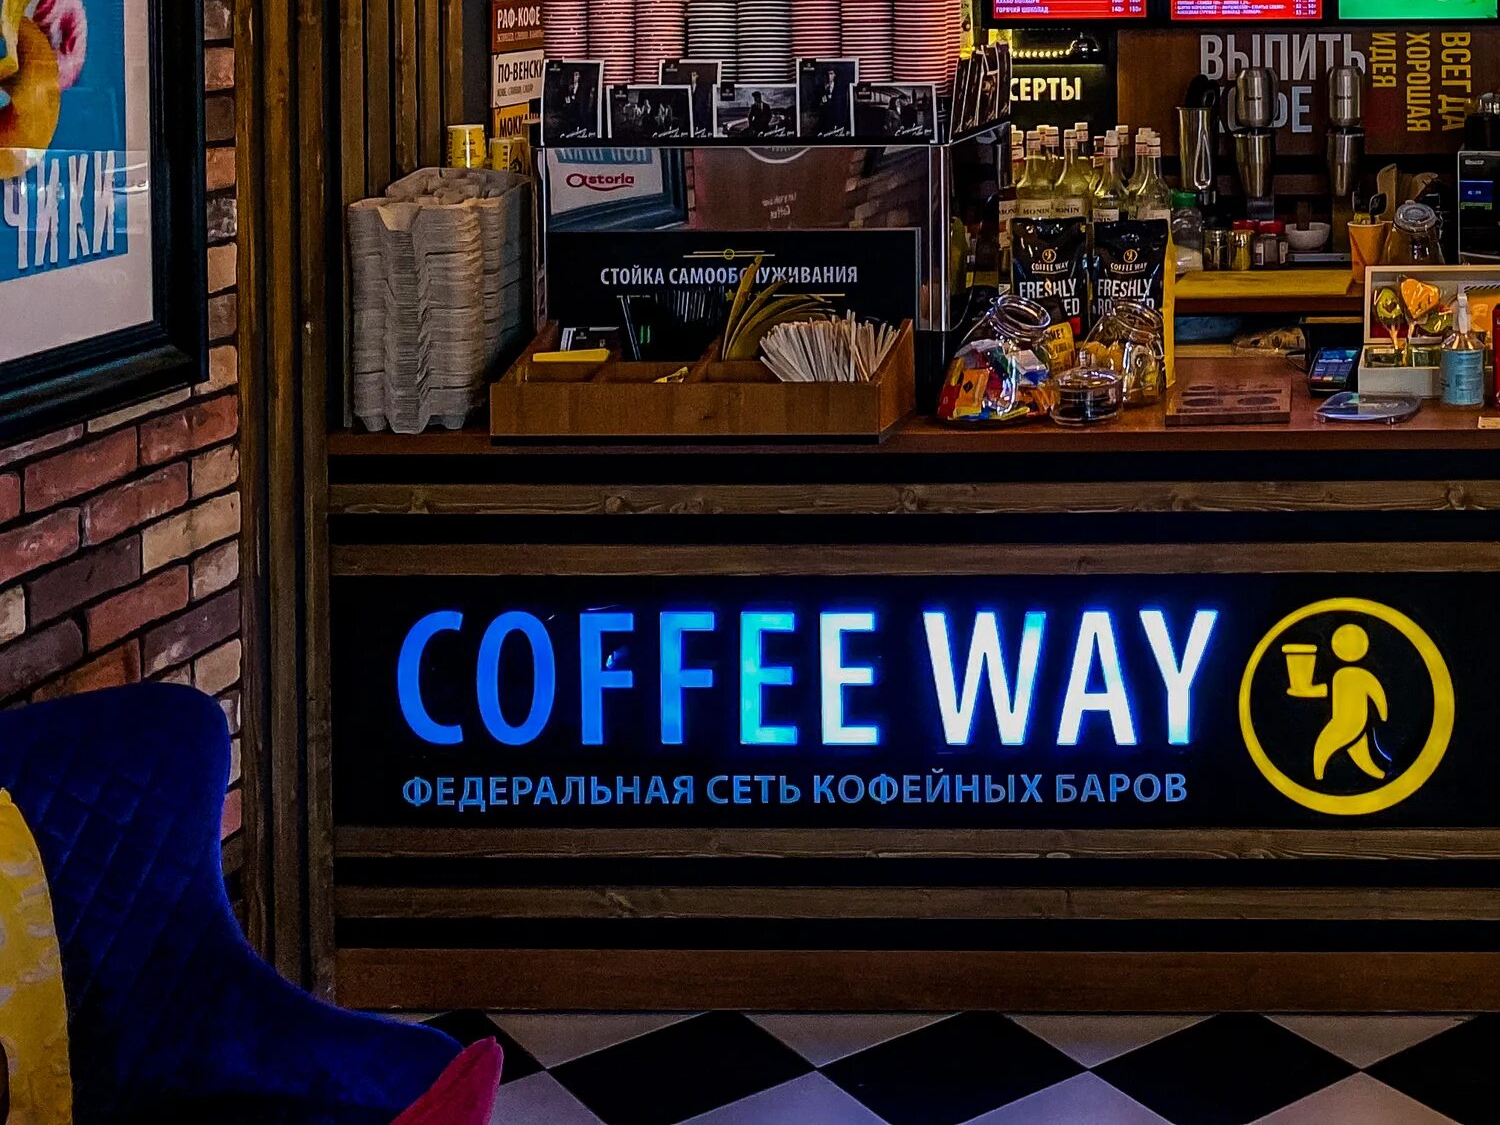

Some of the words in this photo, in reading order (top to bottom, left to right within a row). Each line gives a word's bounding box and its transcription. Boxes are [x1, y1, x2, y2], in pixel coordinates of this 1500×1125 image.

[497, 6, 541, 29] РАФ-КОФЕ
[1200, 33, 1366, 81] ВЫПИТЬ
[1368, 32, 1397, 88] ИДЕЯ
[1010, 77, 1082, 101] СЕРТЫ
[1406, 32, 1431, 132] ХОРОШАЯ
[1438, 32, 1472, 132] ВСЕГДА
[3, 150, 115, 270] ЧИКИ
[600, 264, 665, 285] СТОЙКА
[1031, 262, 1053, 272] COFFEE
[1054, 260, 1069, 271] WAY
[1110, 263, 1137, 272] COFFEE
[1019, 278, 1077, 299] FRESHLY
[1098, 277, 1153, 298] FRESHLY
[397, 609, 881, 747] COFFEE
[921, 608, 1219, 746] WAY
[401, 773, 697, 811] ФЕДЕРАЛЬНАЯ
[705, 773, 801, 807] СЕТЬ
[812, 766, 1043, 807] КОФЕЙНЫХ
[1054, 770, 1188, 805] БАРОВ
